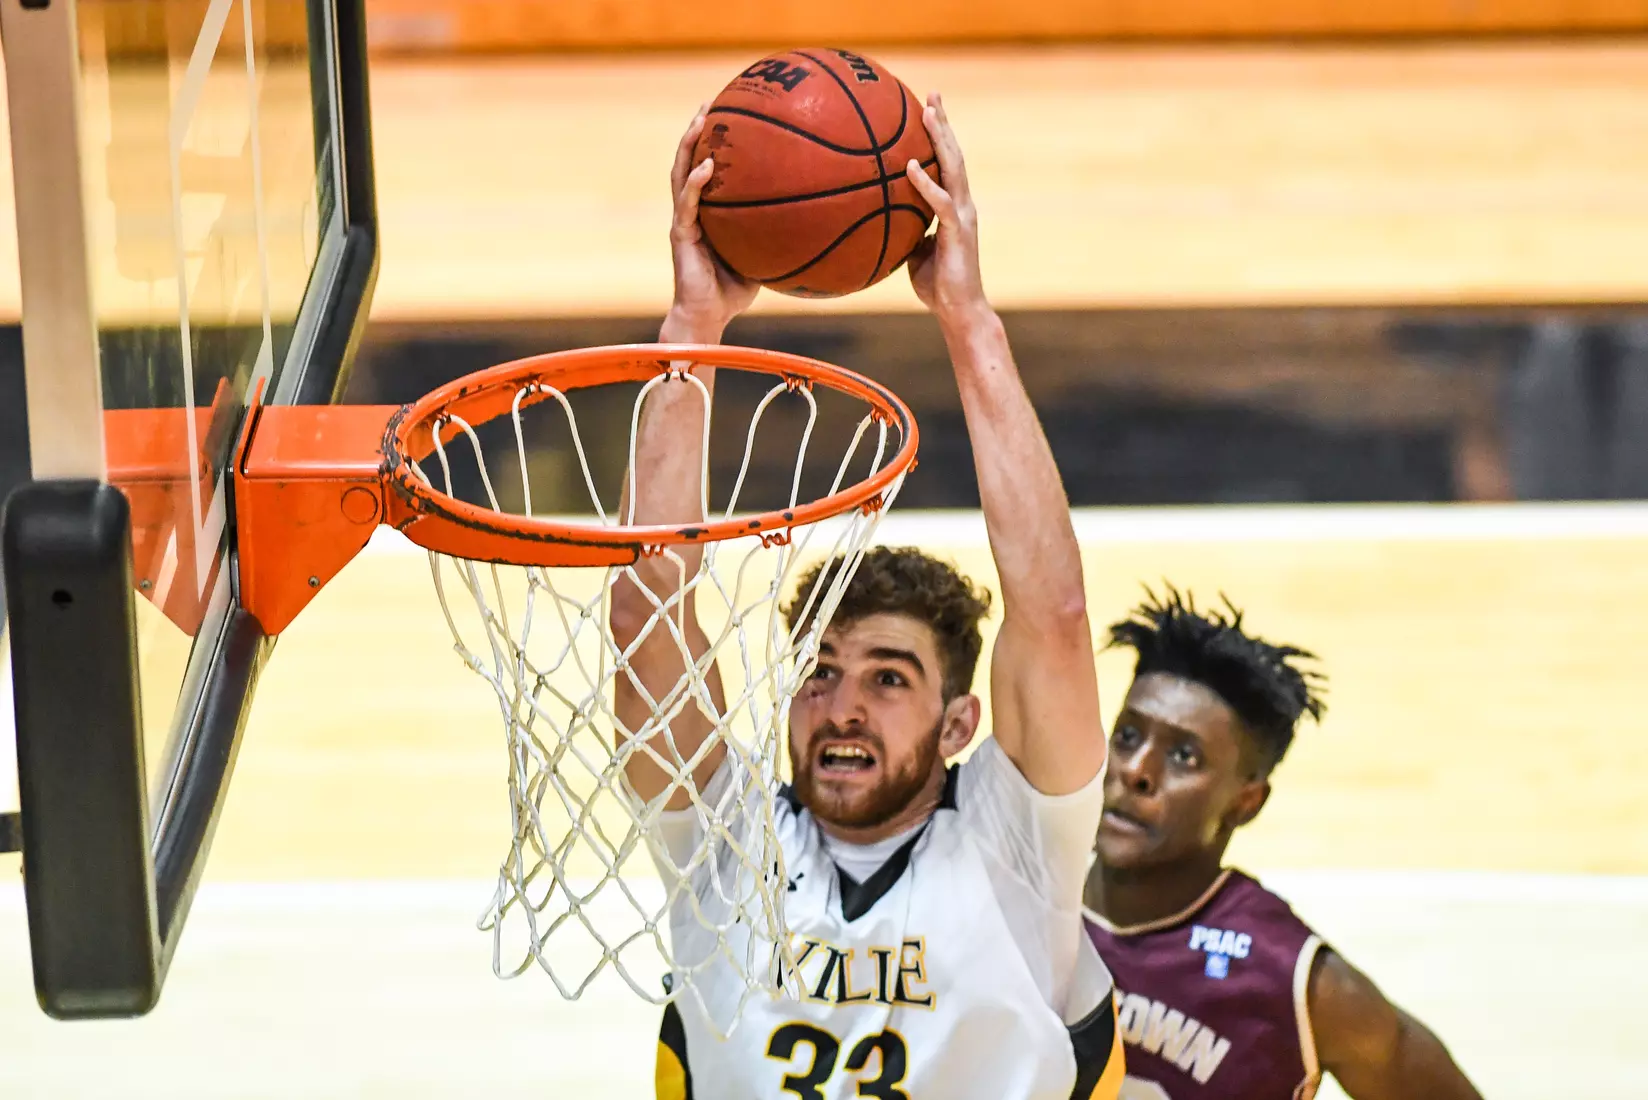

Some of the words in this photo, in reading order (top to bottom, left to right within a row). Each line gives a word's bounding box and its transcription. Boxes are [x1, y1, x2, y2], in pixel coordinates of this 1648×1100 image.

[741, 59, 810, 92] CAA
[1189, 925, 1252, 958] PSAC
[765, 1019, 913, 1100] 33
